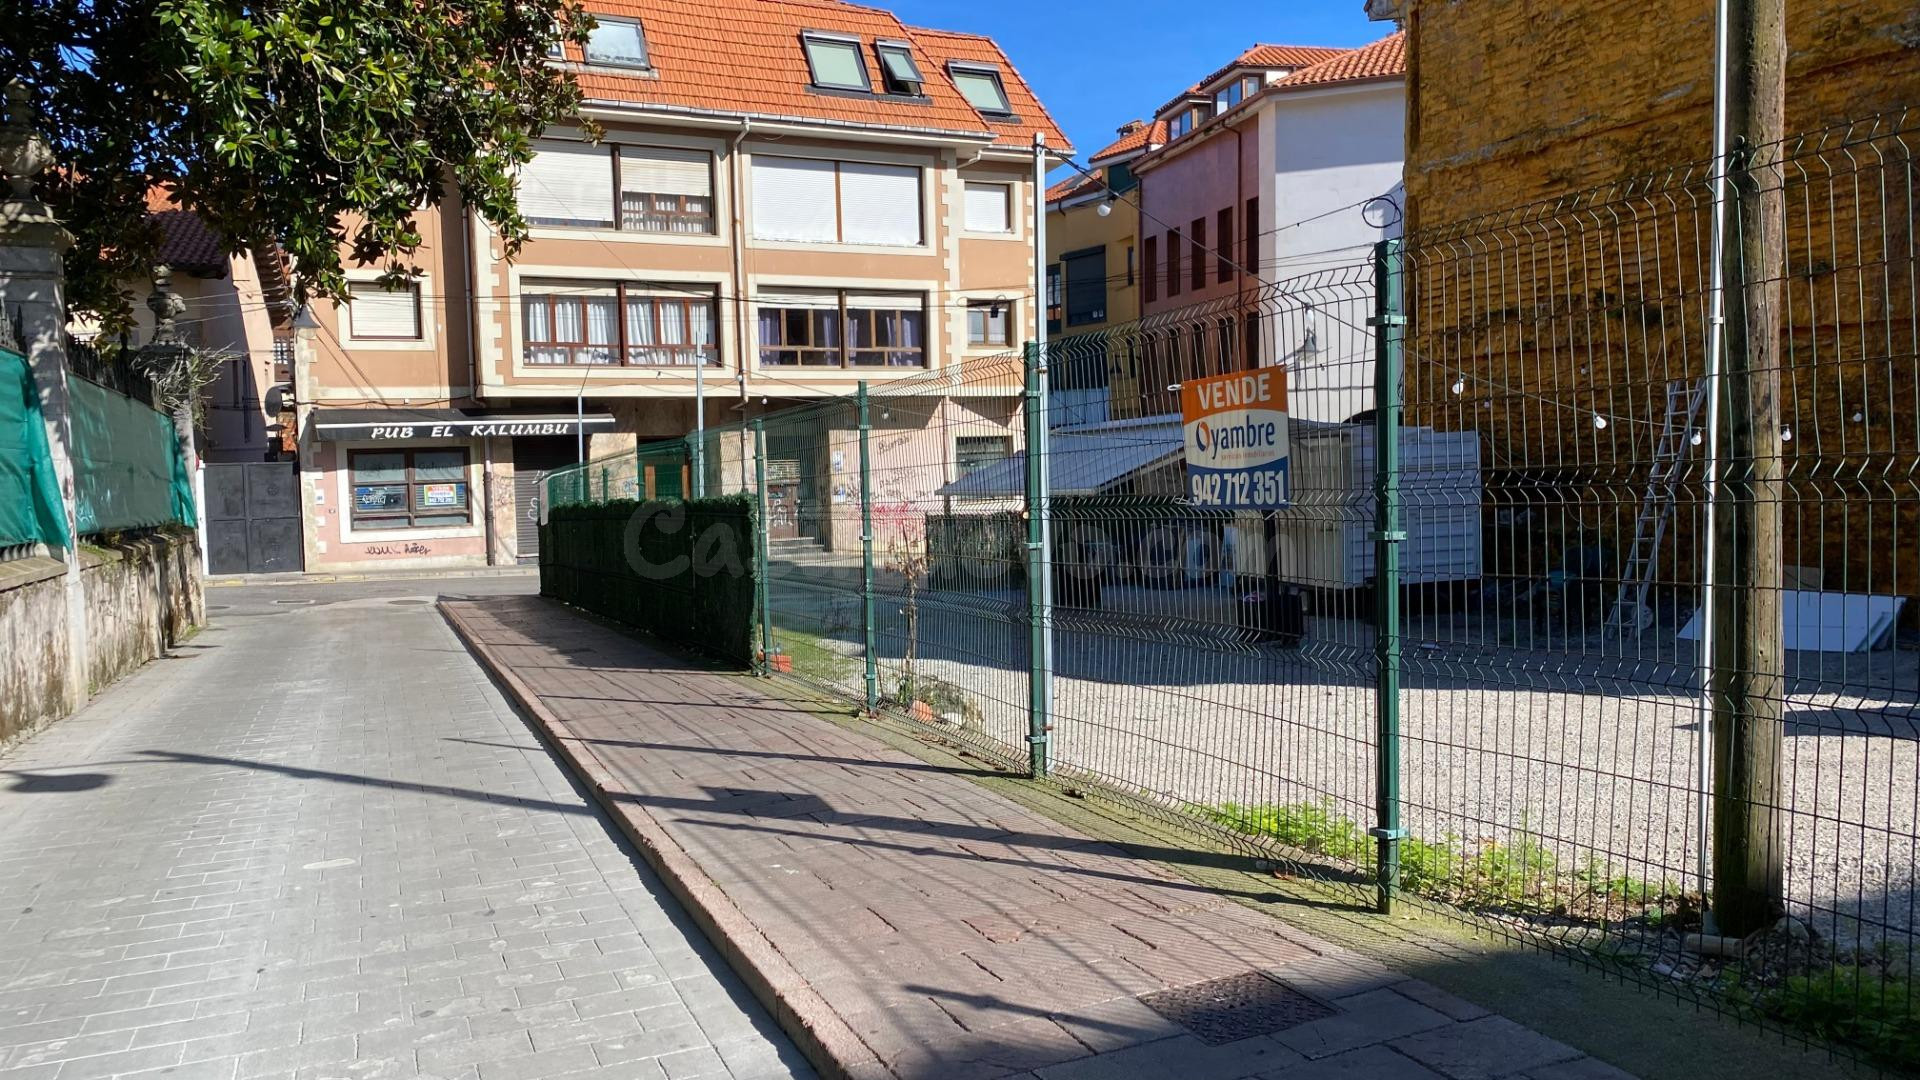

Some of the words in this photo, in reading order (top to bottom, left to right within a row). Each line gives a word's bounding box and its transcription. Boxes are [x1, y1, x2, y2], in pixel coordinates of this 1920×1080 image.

[1198, 373, 1271, 410] VENDE
[371, 426, 414, 439] PUB
[431, 425, 454, 438] EL
[470, 423, 569, 436] KALUMBU
[1196, 415, 1275, 460] Oyambre
[1192, 473, 1221, 506] 942
[1224, 472, 1251, 505] 712
[1254, 470, 1286, 504] 351
